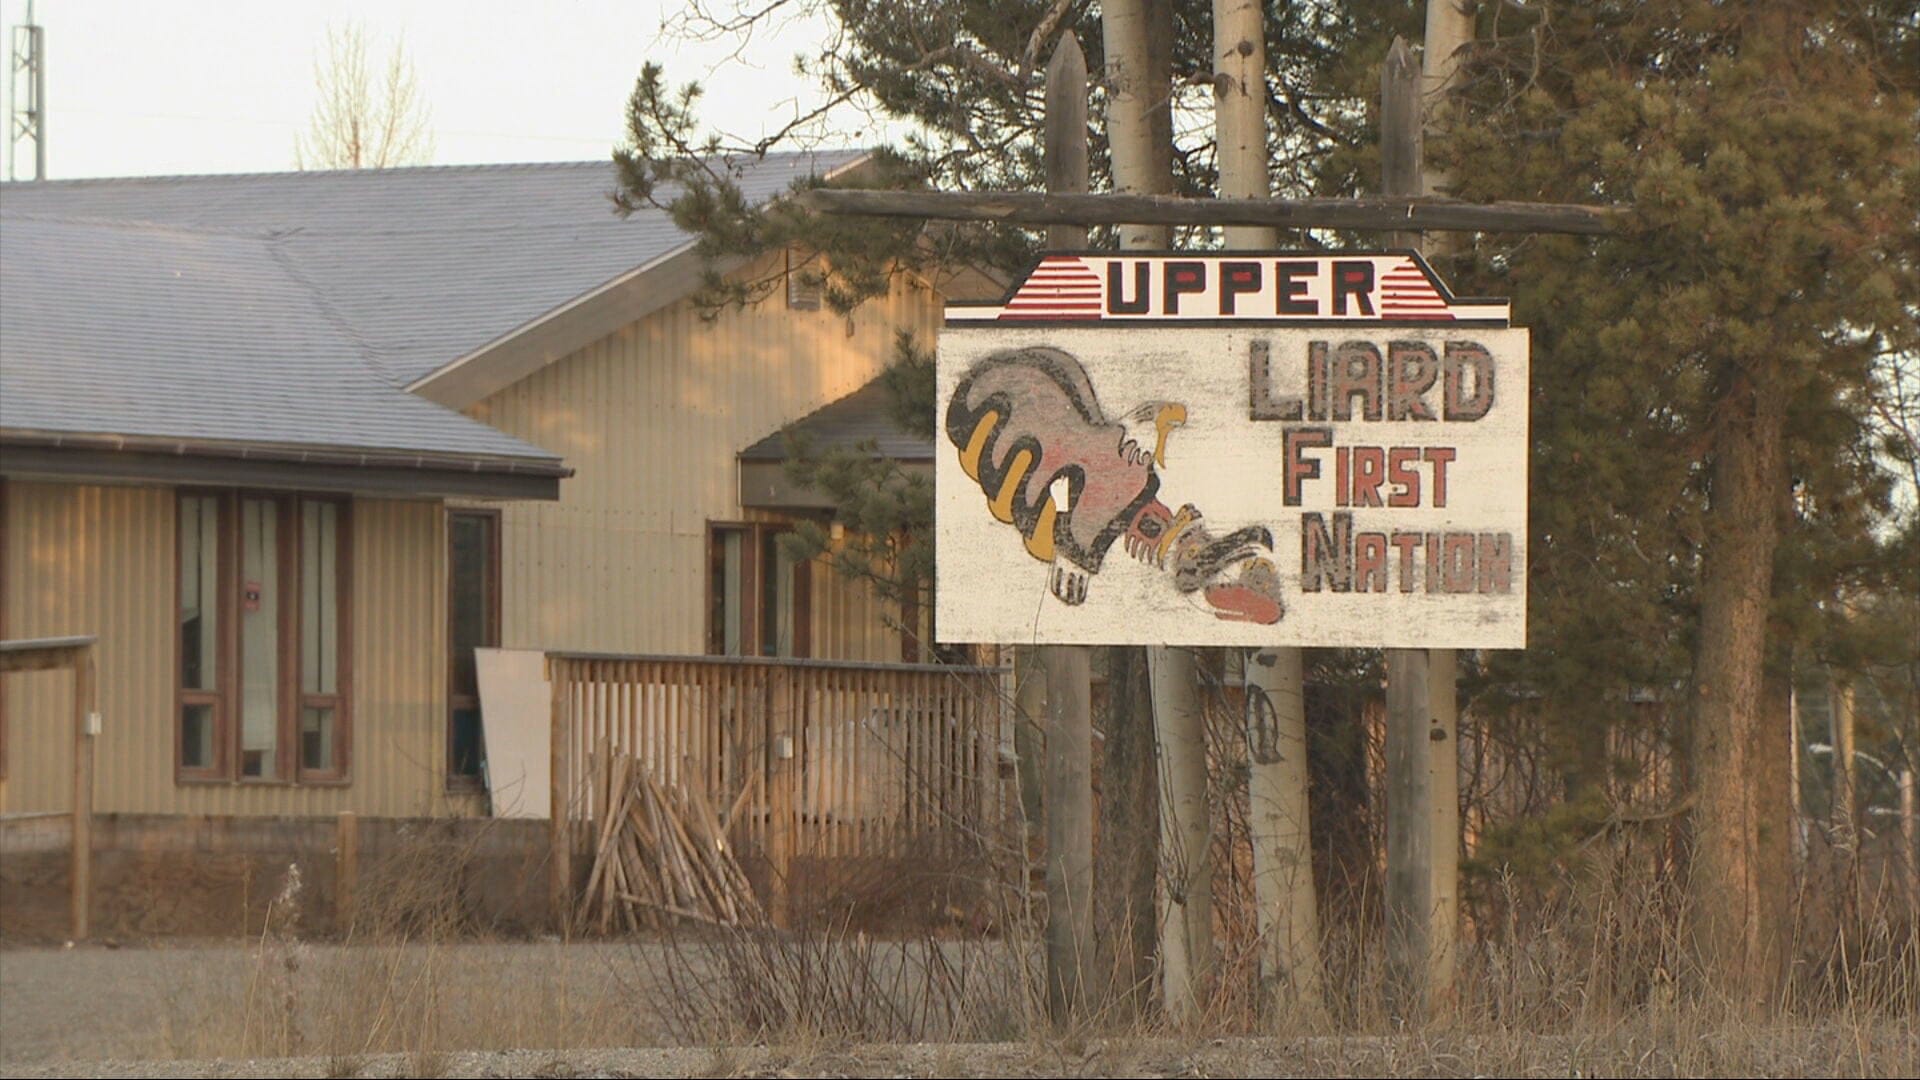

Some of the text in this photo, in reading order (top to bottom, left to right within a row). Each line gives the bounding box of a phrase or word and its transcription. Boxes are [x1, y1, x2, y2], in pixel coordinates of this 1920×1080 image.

[1106, 260, 1376, 316] UPPER
[1249, 340, 1496, 422] LIARD
[1282, 427, 1457, 508] FIRST
[1301, 511, 1513, 594] NATION
